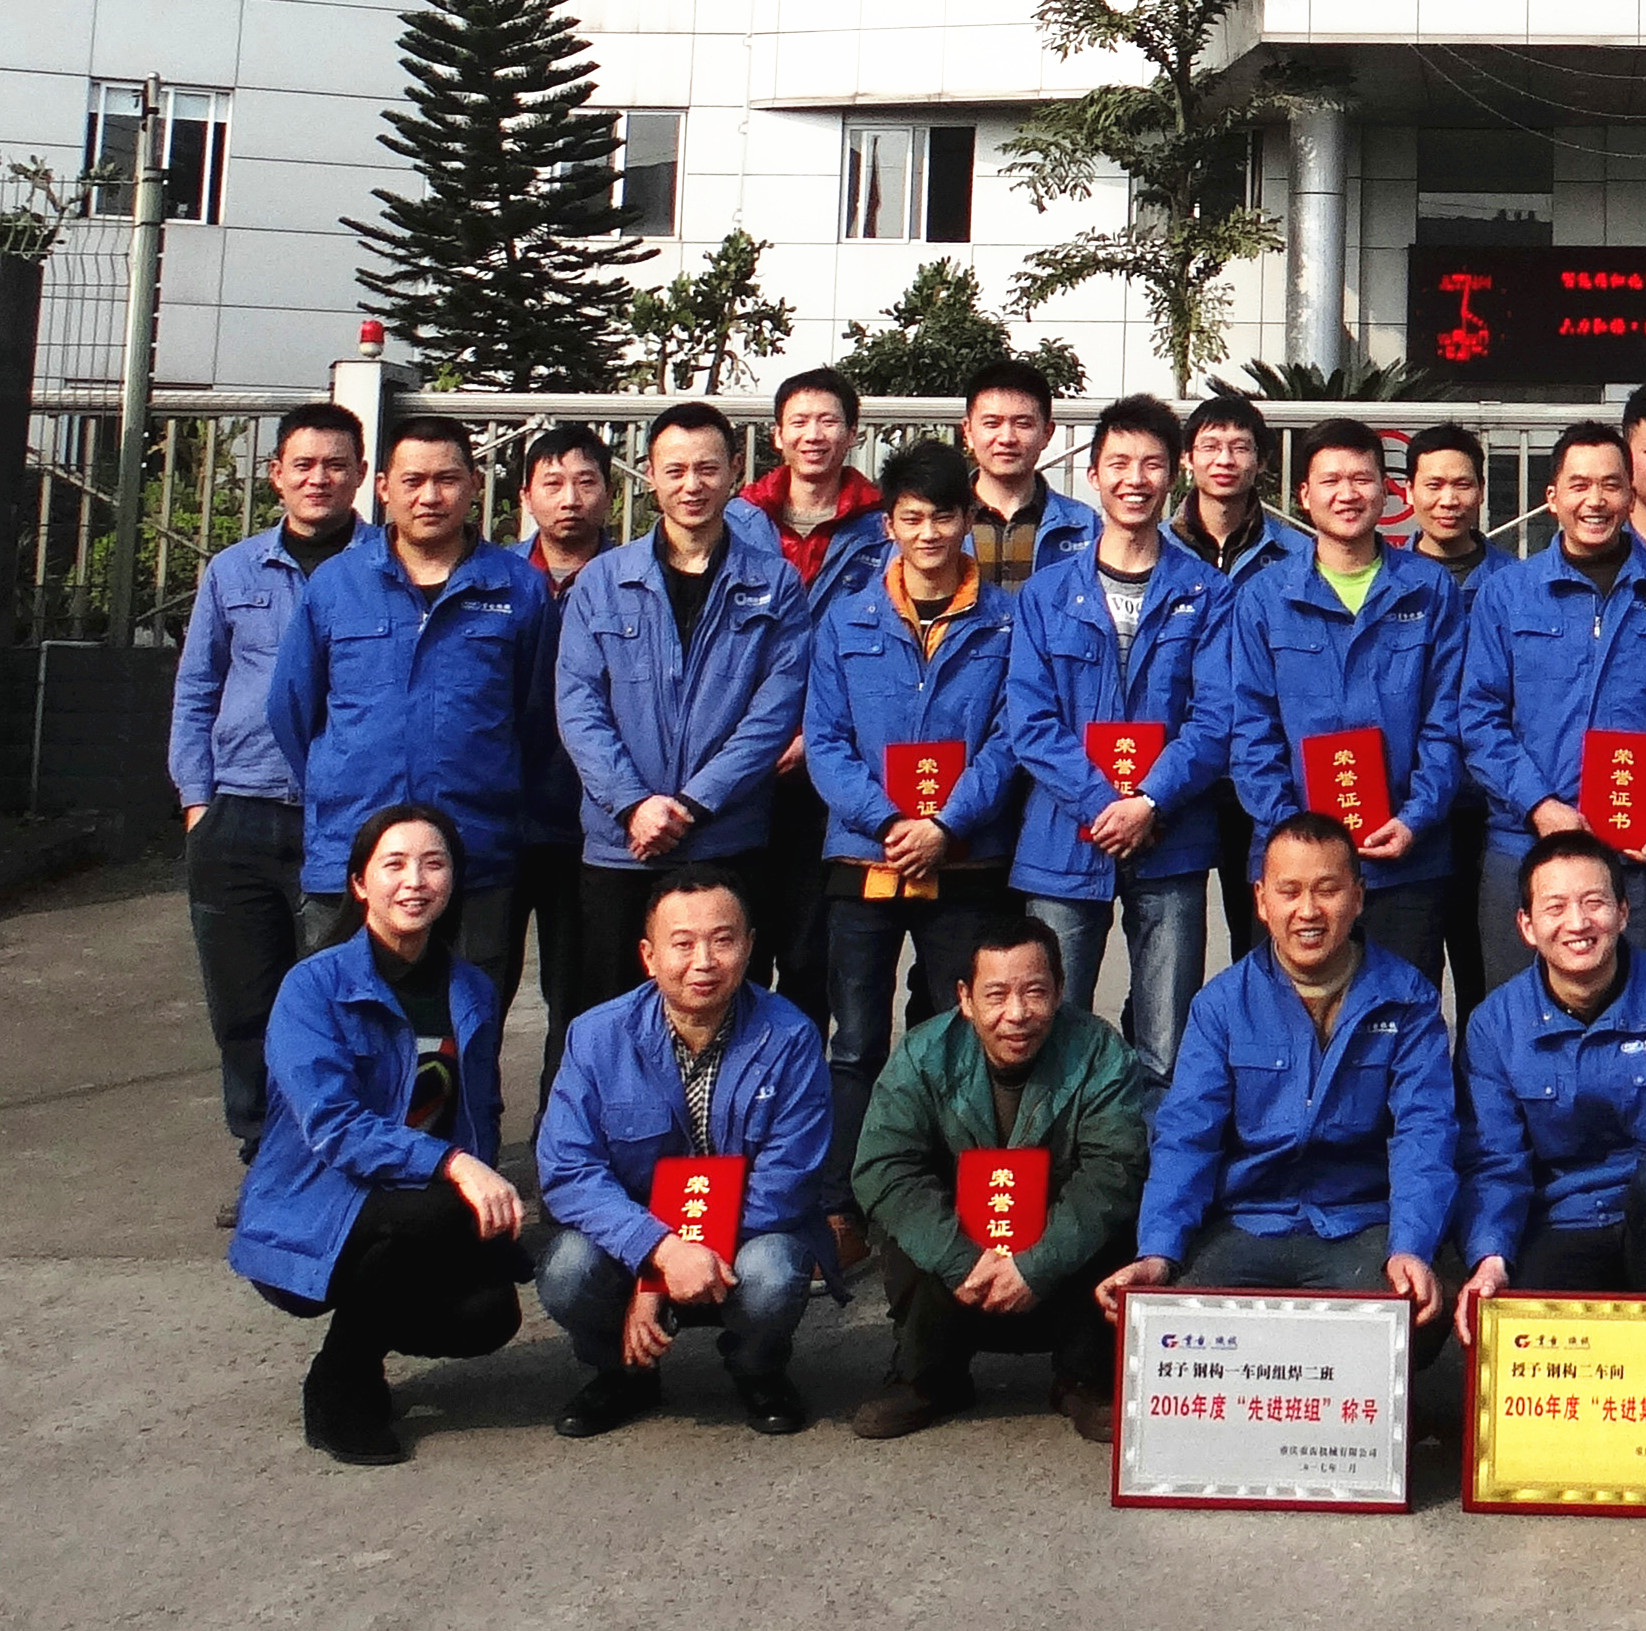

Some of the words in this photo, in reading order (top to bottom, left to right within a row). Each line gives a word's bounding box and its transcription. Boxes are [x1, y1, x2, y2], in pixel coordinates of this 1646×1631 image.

[1332, 749, 1363, 830] 荣誉证书
[1608, 749, 1636, 829] 荣誉证书
[1158, 1361, 1189, 1378] 授予
[1512, 1362, 1542, 1378] 授予
[1547, 1362, 1625, 1380] 钢构二车间
